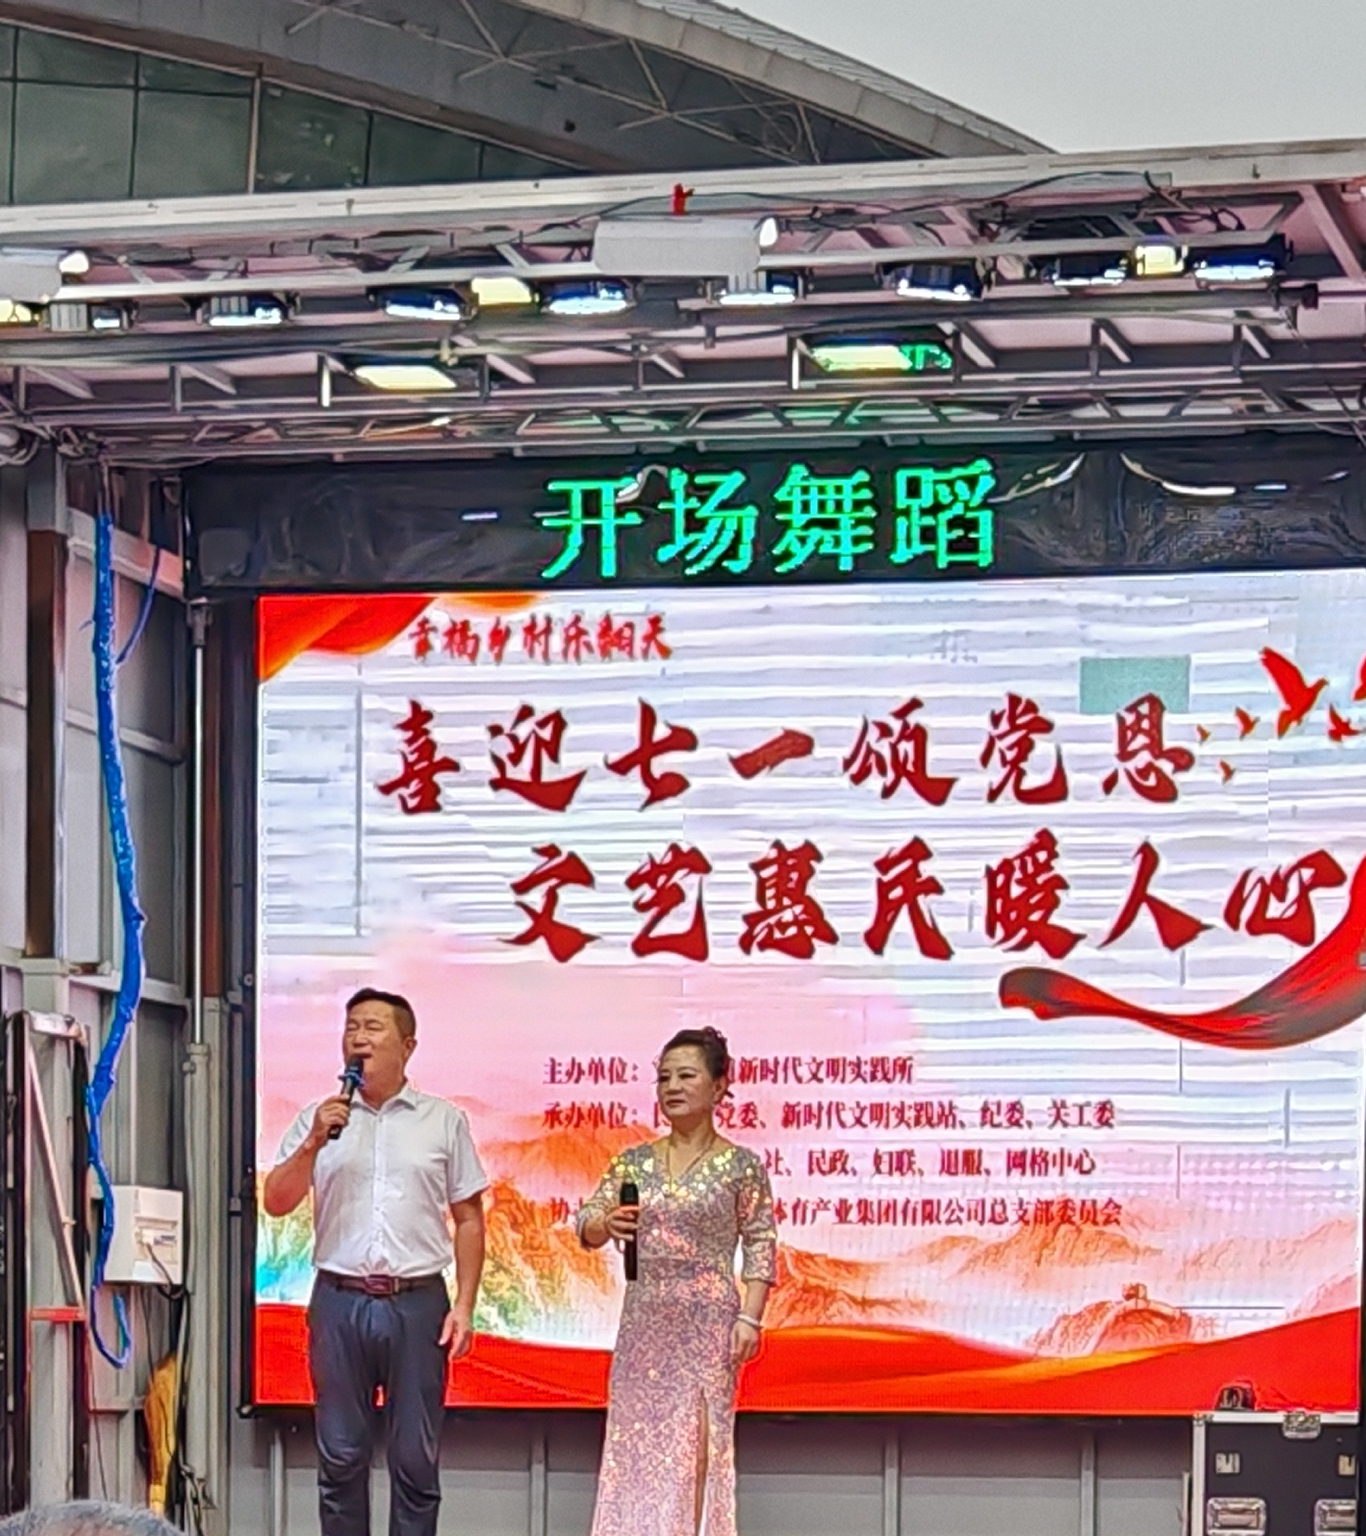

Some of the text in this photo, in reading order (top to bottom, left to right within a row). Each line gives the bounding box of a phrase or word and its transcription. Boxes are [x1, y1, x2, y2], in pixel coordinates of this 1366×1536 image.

[542, 458, 996, 579] 开场舞蹈
[374, 691, 1195, 815] 喜迎七一颂党恩
[498, 827, 1348, 963] 文艺惠民暖人心
